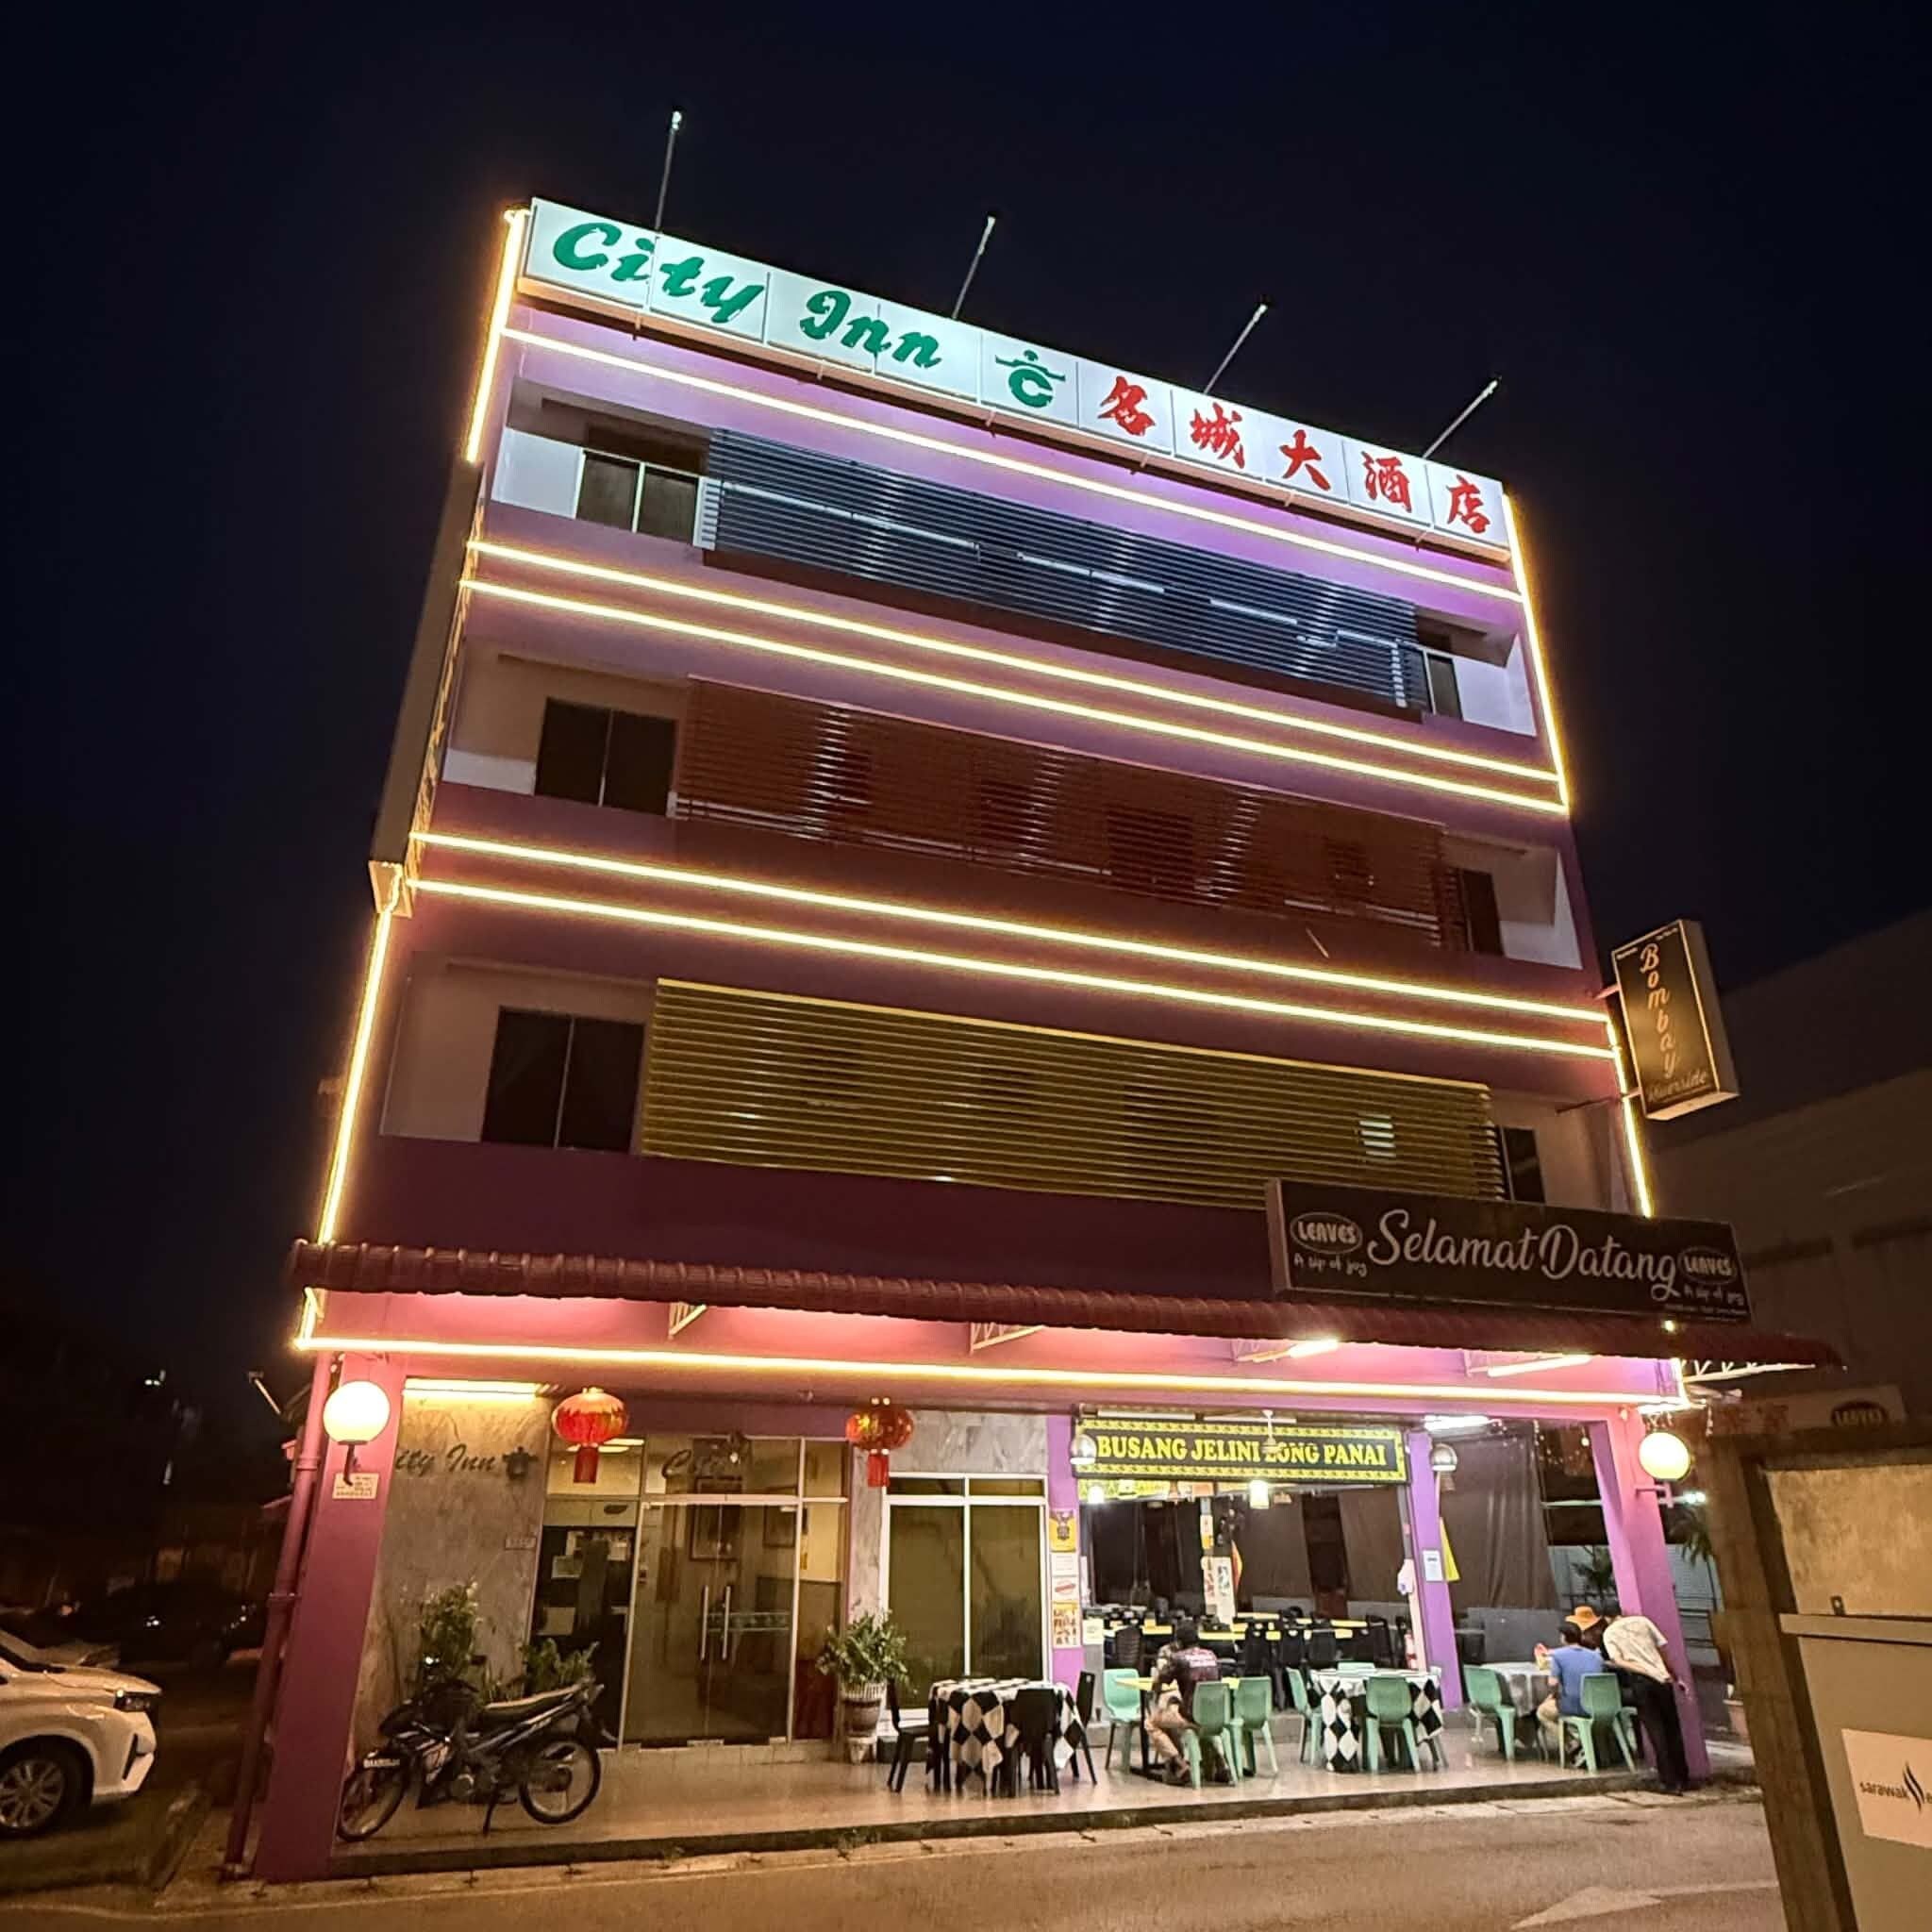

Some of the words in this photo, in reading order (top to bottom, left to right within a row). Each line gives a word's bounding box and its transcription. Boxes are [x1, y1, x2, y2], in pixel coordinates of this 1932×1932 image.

[553, 221, 765, 324] City
[799, 290, 942, 369] Inn
[1097, 375, 1491, 535] 名城大酒店
[1639, 942, 1678, 1079] Bombay
[1367, 1208, 1540, 1271] Selamat
[1539, 1224, 1681, 1302] Datang
[394, 1449, 436, 1477] ity
[446, 1442, 496, 1474] Inn
[1095, 1435, 1189, 1461] BUSANG
[1191, 1438, 1261, 1463] JELINI
[1323, 1443, 1387, 1466] PANAI
